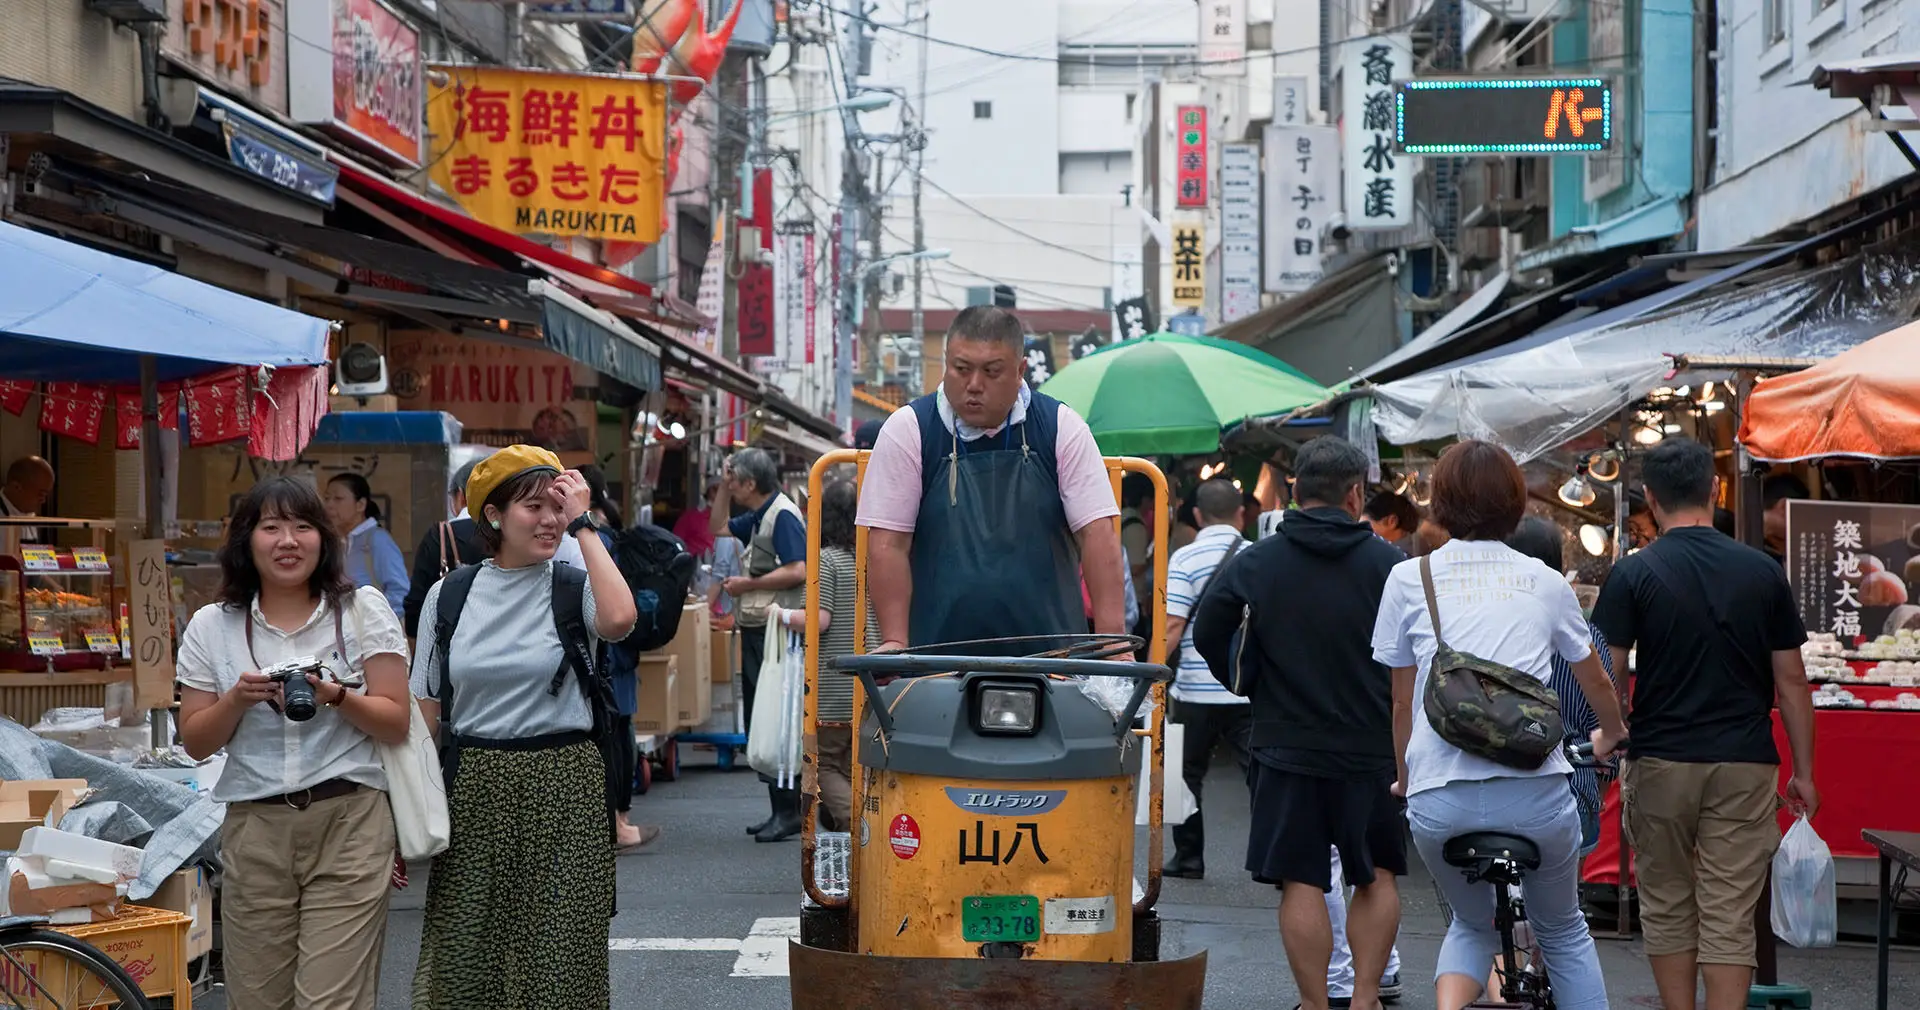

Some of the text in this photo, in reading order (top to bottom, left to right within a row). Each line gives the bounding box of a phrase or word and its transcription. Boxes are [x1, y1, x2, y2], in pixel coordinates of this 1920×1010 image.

[453, 86, 644, 152] 海鮮丼
[451, 153, 641, 206] まるきた
[516, 206, 636, 235] MARUKITA
[1174, 229, 1202, 281] 茶
[430, 364, 575, 404] MARUKITA
[1832, 519, 1863, 637] 築地大福
[137, 556, 164, 667] ひもの
[963, 792, 1050, 808] エレトラック
[958, 820, 1050, 866] 山八
[980, 915, 1036, 936] 33-78
